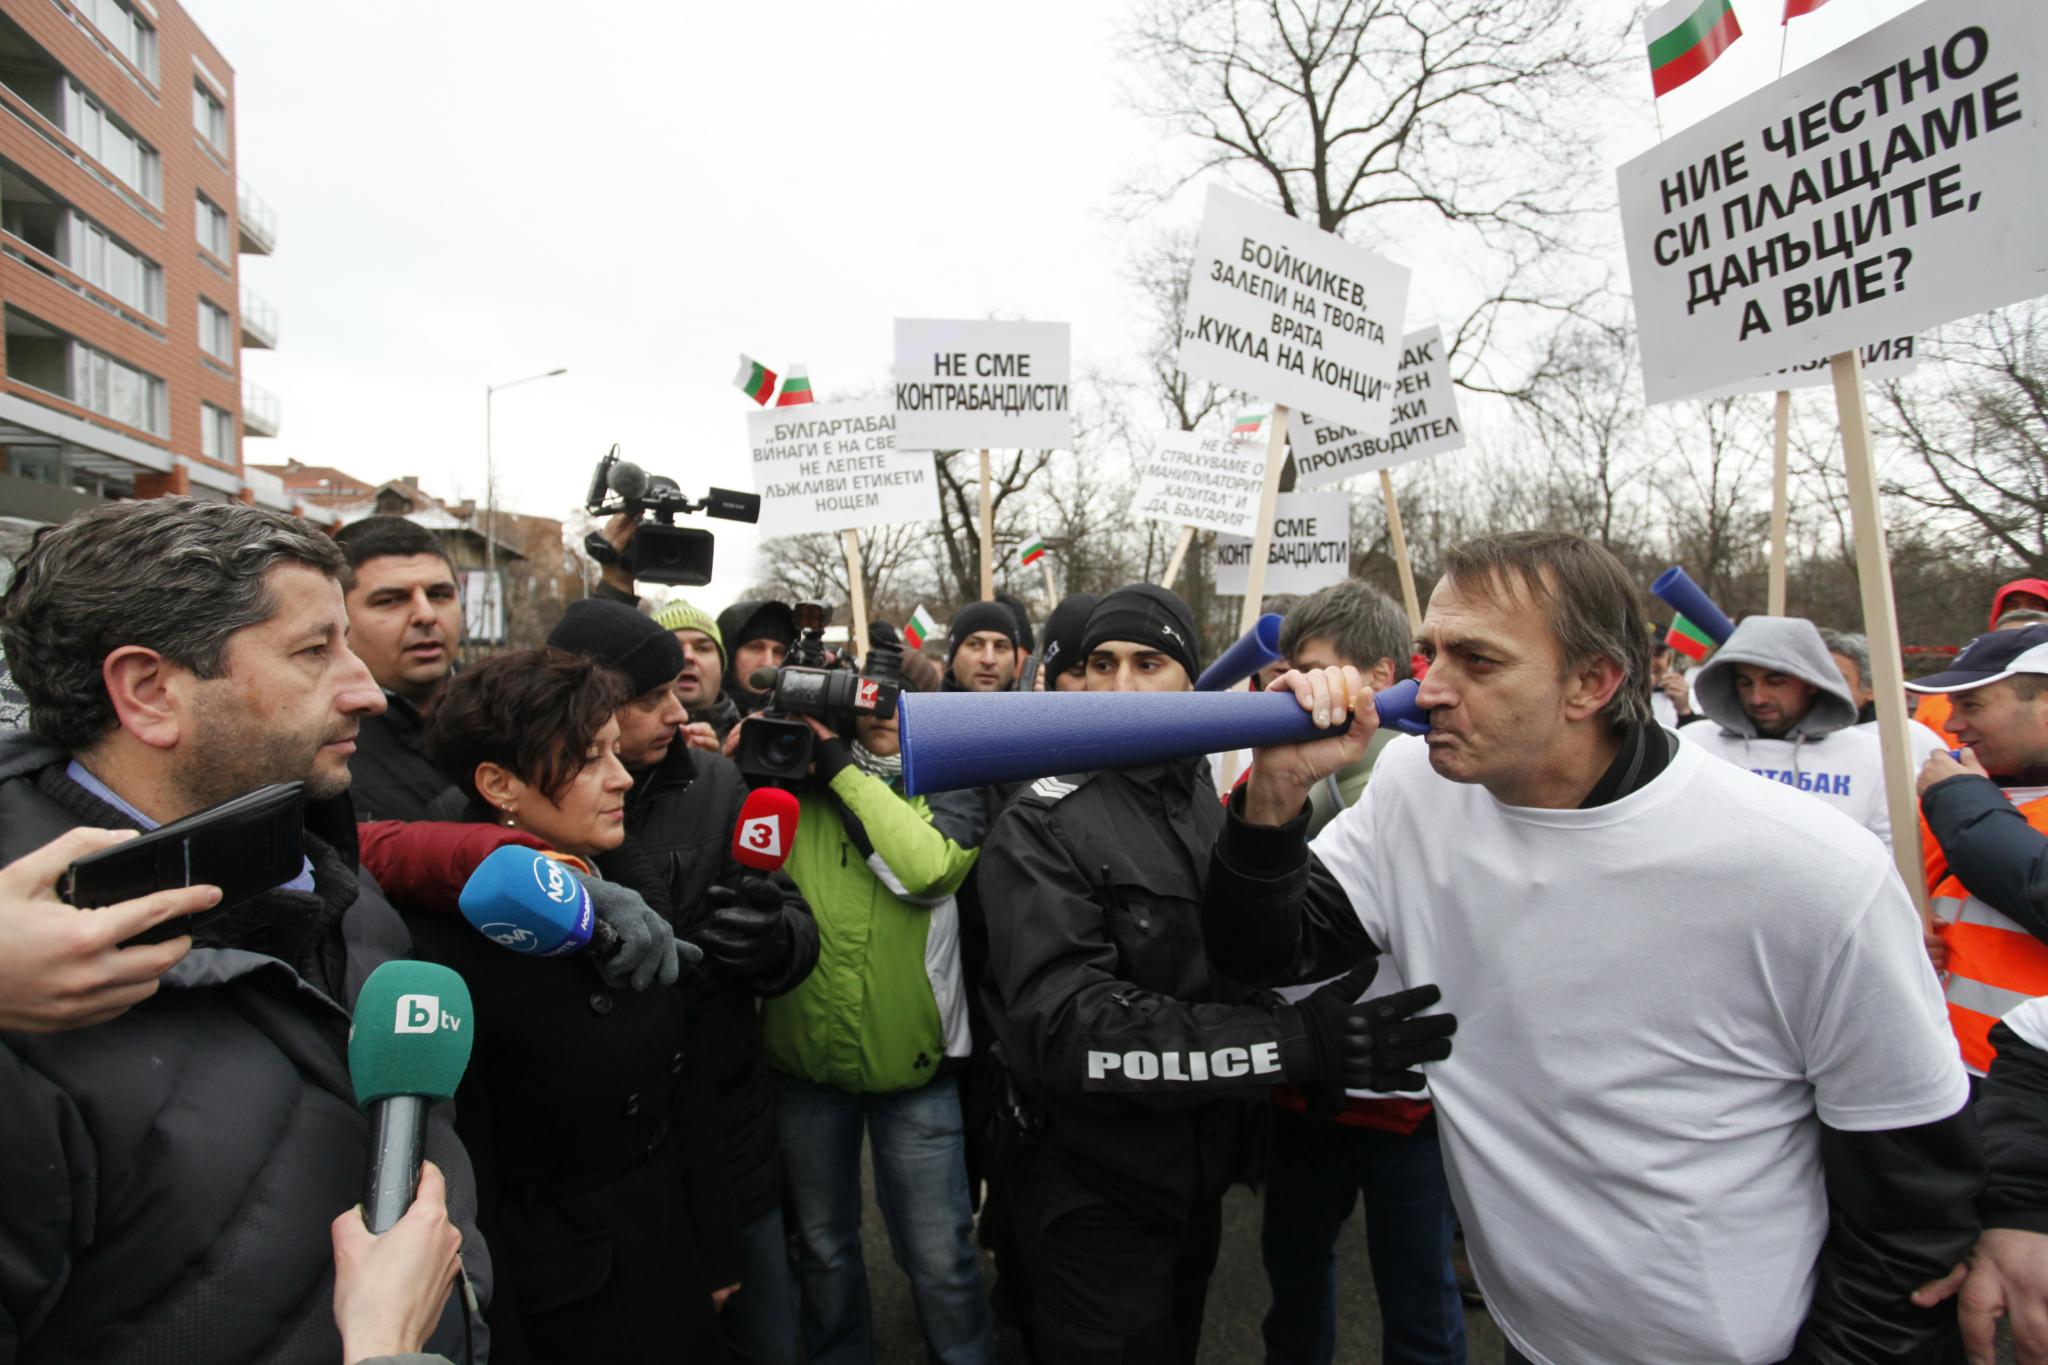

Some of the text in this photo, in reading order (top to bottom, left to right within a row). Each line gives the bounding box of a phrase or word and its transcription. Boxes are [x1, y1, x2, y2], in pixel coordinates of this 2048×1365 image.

[1660, 25, 1989, 215] НИЕ ЧЕСТНО
[1653, 73, 2023, 267] СИ ПЛАЩАМЕ
[1686, 164, 1983, 316] ДАНЪЦИТЕ,
[1240, 237, 1368, 311] БОЙКИКЕВ,
[1211, 259, 1385, 345] ЗАЛЕПИ НА ТВОЯТА
[1738, 247, 1913, 342] А ВИЕ?
[1270, 313, 1323, 350] ВРАТА
[934, 353, 1031, 378] НЕ СМЕ
[1184, 314, 1392, 402] „КУКЛА НА КОНЦИ“
[896, 383, 1068, 417] КОНТРАБАНДИСТИ
[753, 435, 896, 462] ВИНАГИ Е НА СВЕ
[1200, 439, 1239, 455] НЕ СЕ
[1298, 416, 1459, 475] ПРОИЗВОДИТЕЛ
[800, 455, 886, 476] НЕ ЛЕПЕТЕ
[1160, 449, 1250, 474] СТРАХУВАМЕ
[765, 470, 924, 498] ЛЪЖЛИВИ ЕТИКЕТИ
[1147, 464, 1264, 493] МАНИПУЛАТОРИТ
[815, 493, 880, 513] НОЩЕМ
[1235, 497, 1248, 510] И
[1274, 518, 1317, 538] СМЕ
[1218, 541, 1347, 568] КОНТБАНДИСТИ
[749, 823, 773, 849] 3
[1088, 1041, 1281, 1081] POLICE
